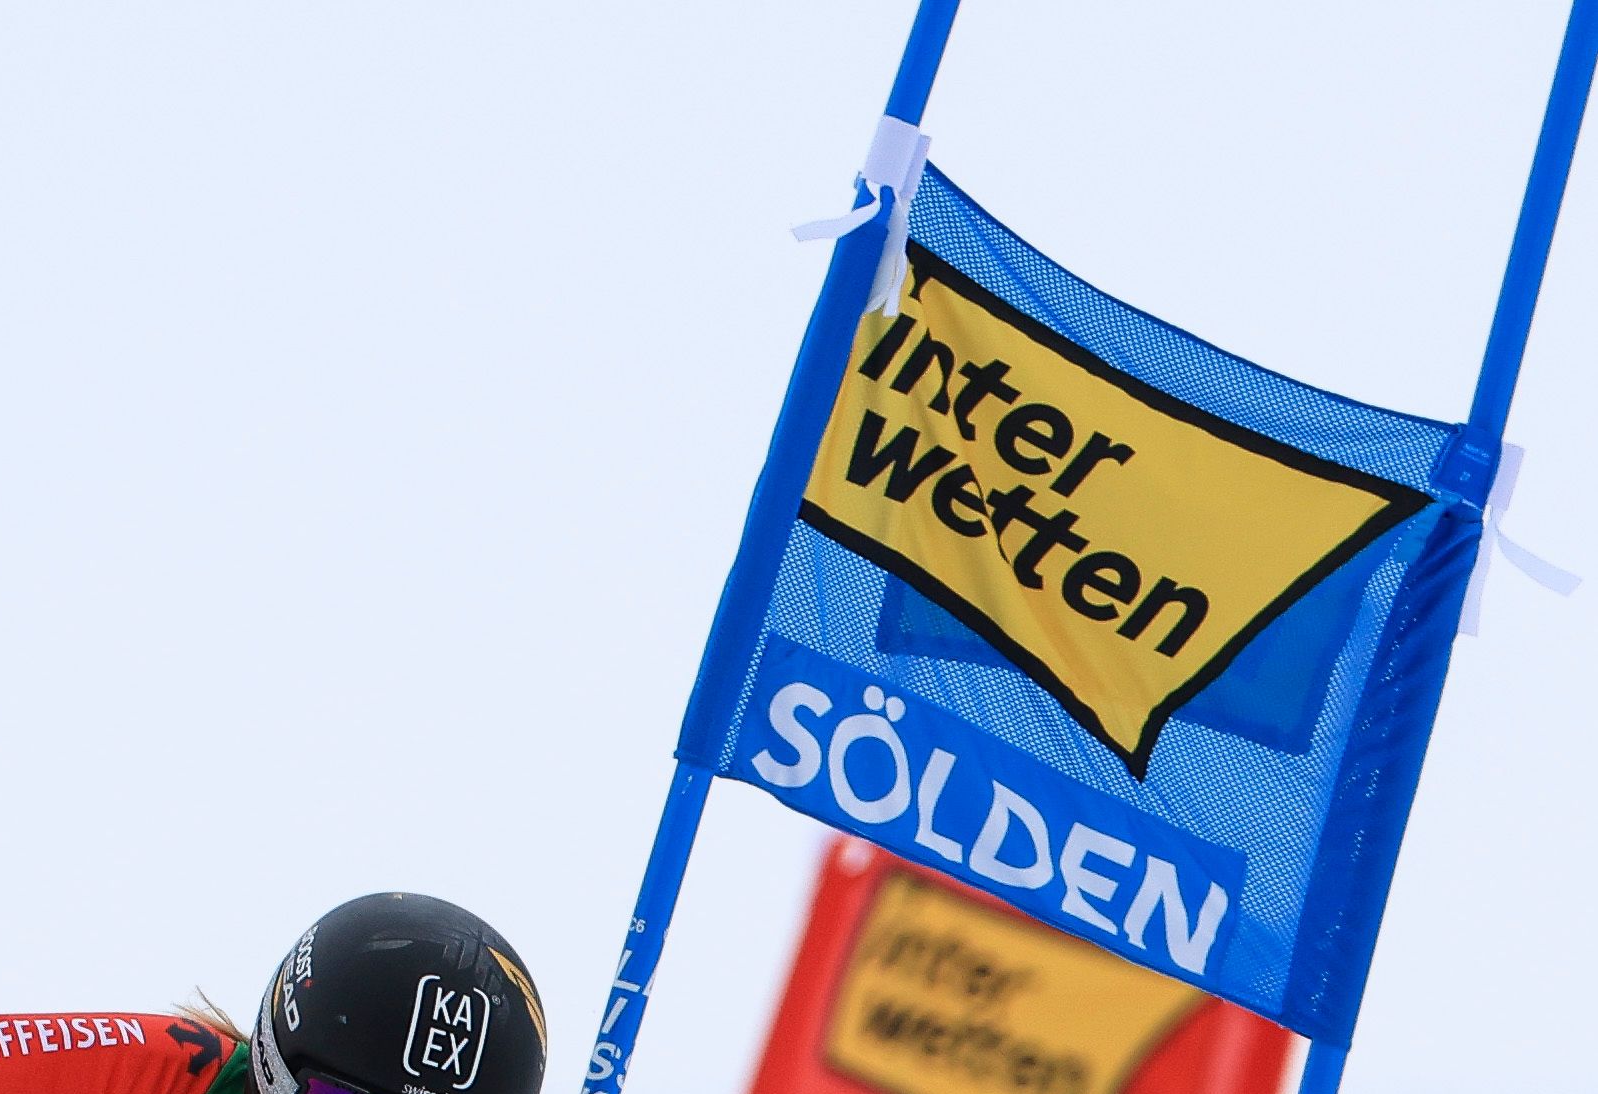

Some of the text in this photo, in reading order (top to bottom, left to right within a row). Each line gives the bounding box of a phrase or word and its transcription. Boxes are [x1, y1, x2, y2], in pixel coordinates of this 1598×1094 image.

[858, 311, 1135, 498] inter
[844, 406, 1211, 660] wetten
[749, 680, 1229, 977] SÖLDEN
[421, 1027, 470, 1076] EX
[432, 986, 472, 1032] KA
